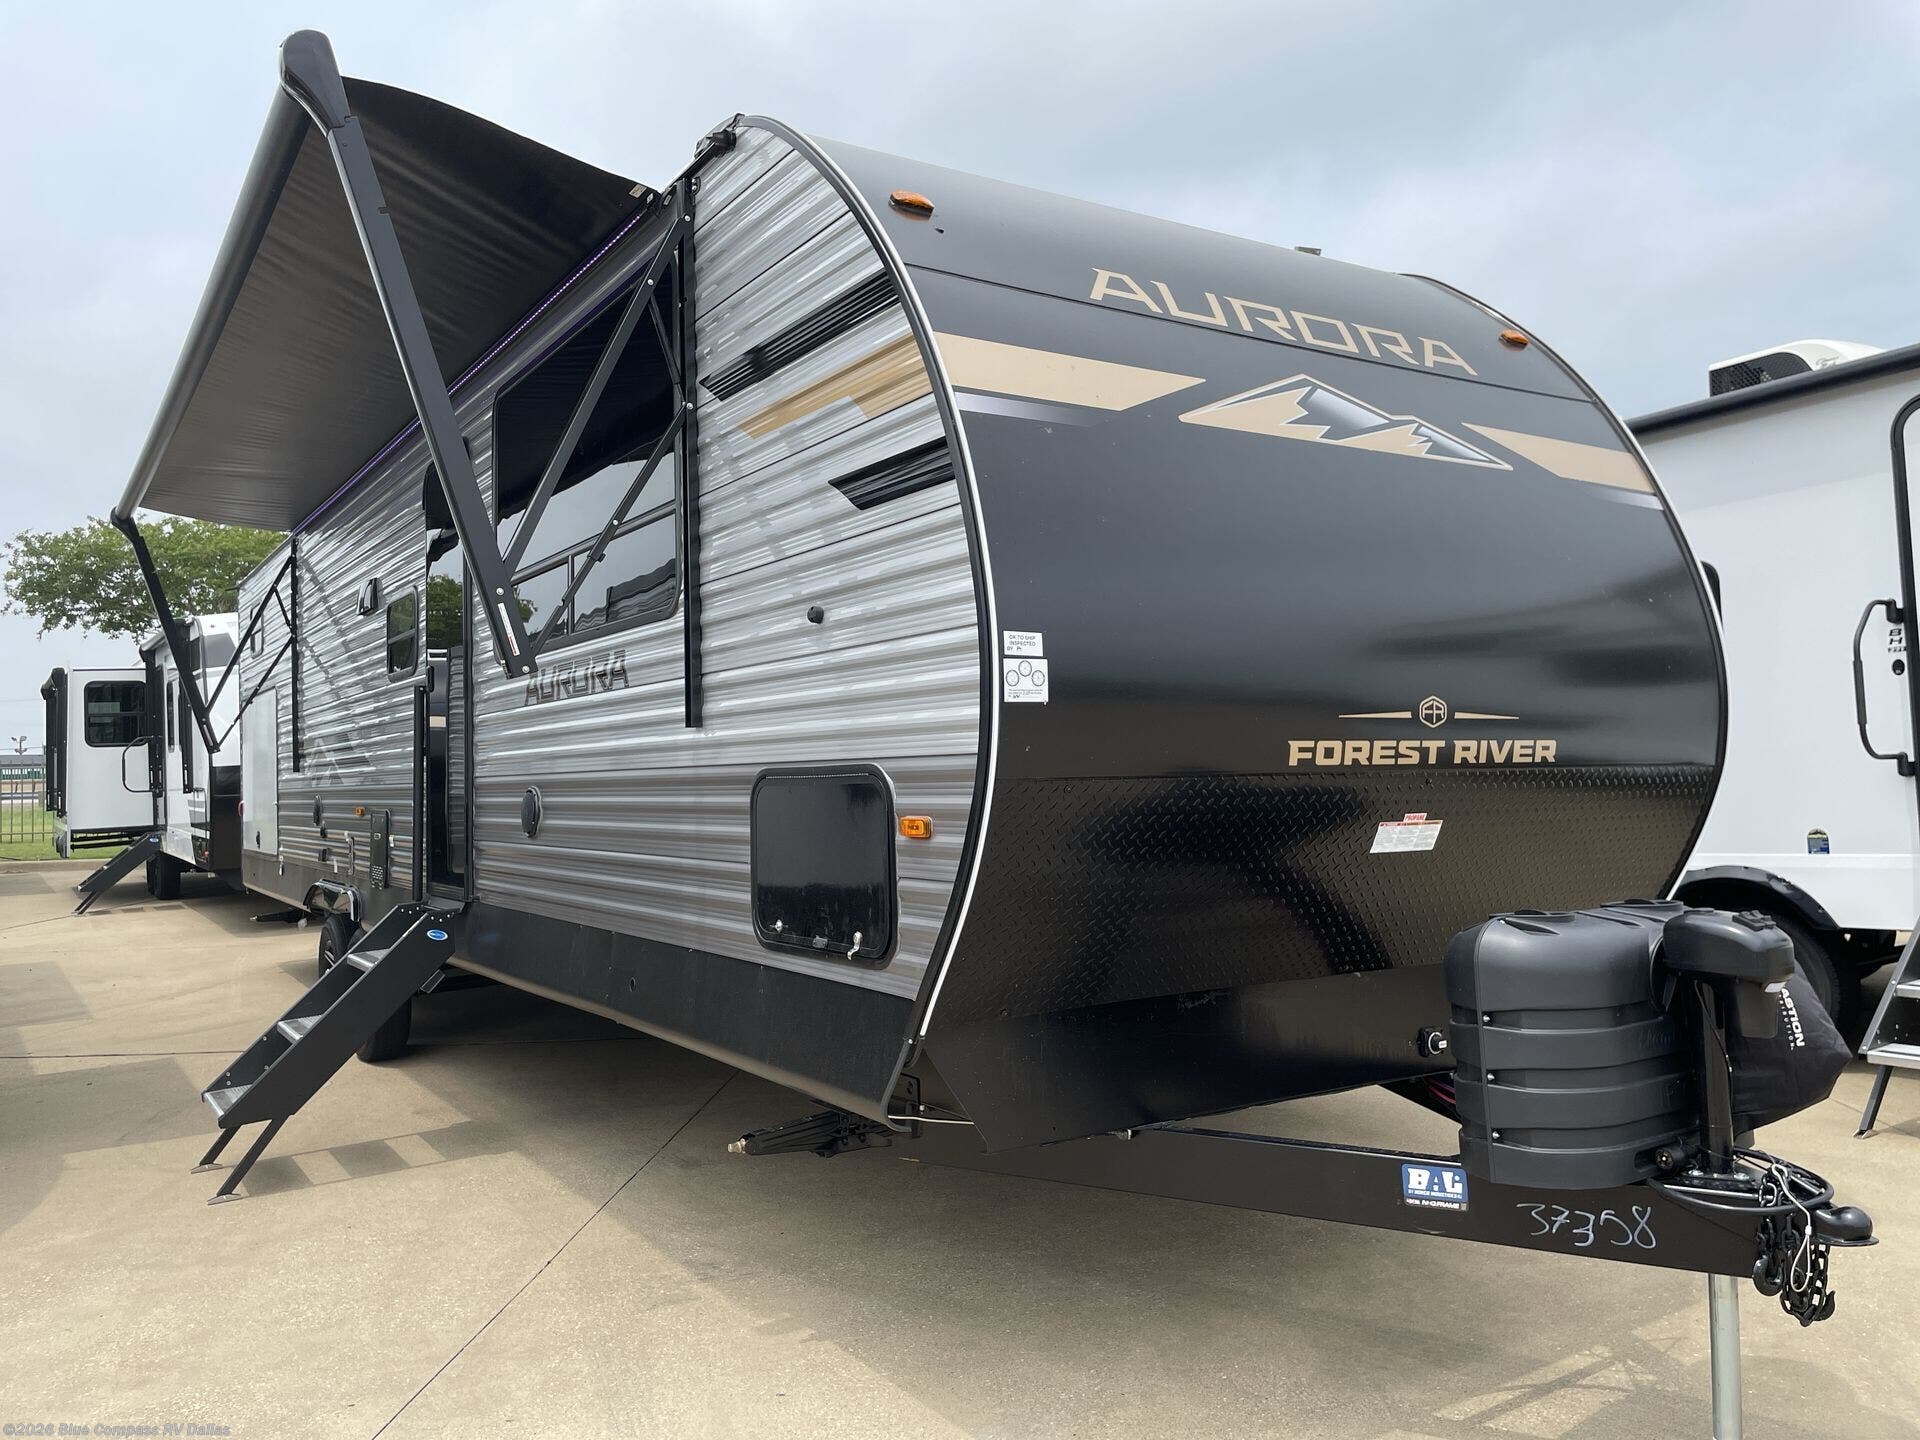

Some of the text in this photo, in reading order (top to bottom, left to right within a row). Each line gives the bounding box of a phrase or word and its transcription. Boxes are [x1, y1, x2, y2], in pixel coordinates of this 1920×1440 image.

[1089, 267, 1478, 376] AURORA
[524, 649, 630, 706] AURORA
[1287, 739, 1558, 767] FOREST RIVER
[1781, 988, 1805, 1047] ASTION
[1516, 1203, 1657, 1249] 37358
